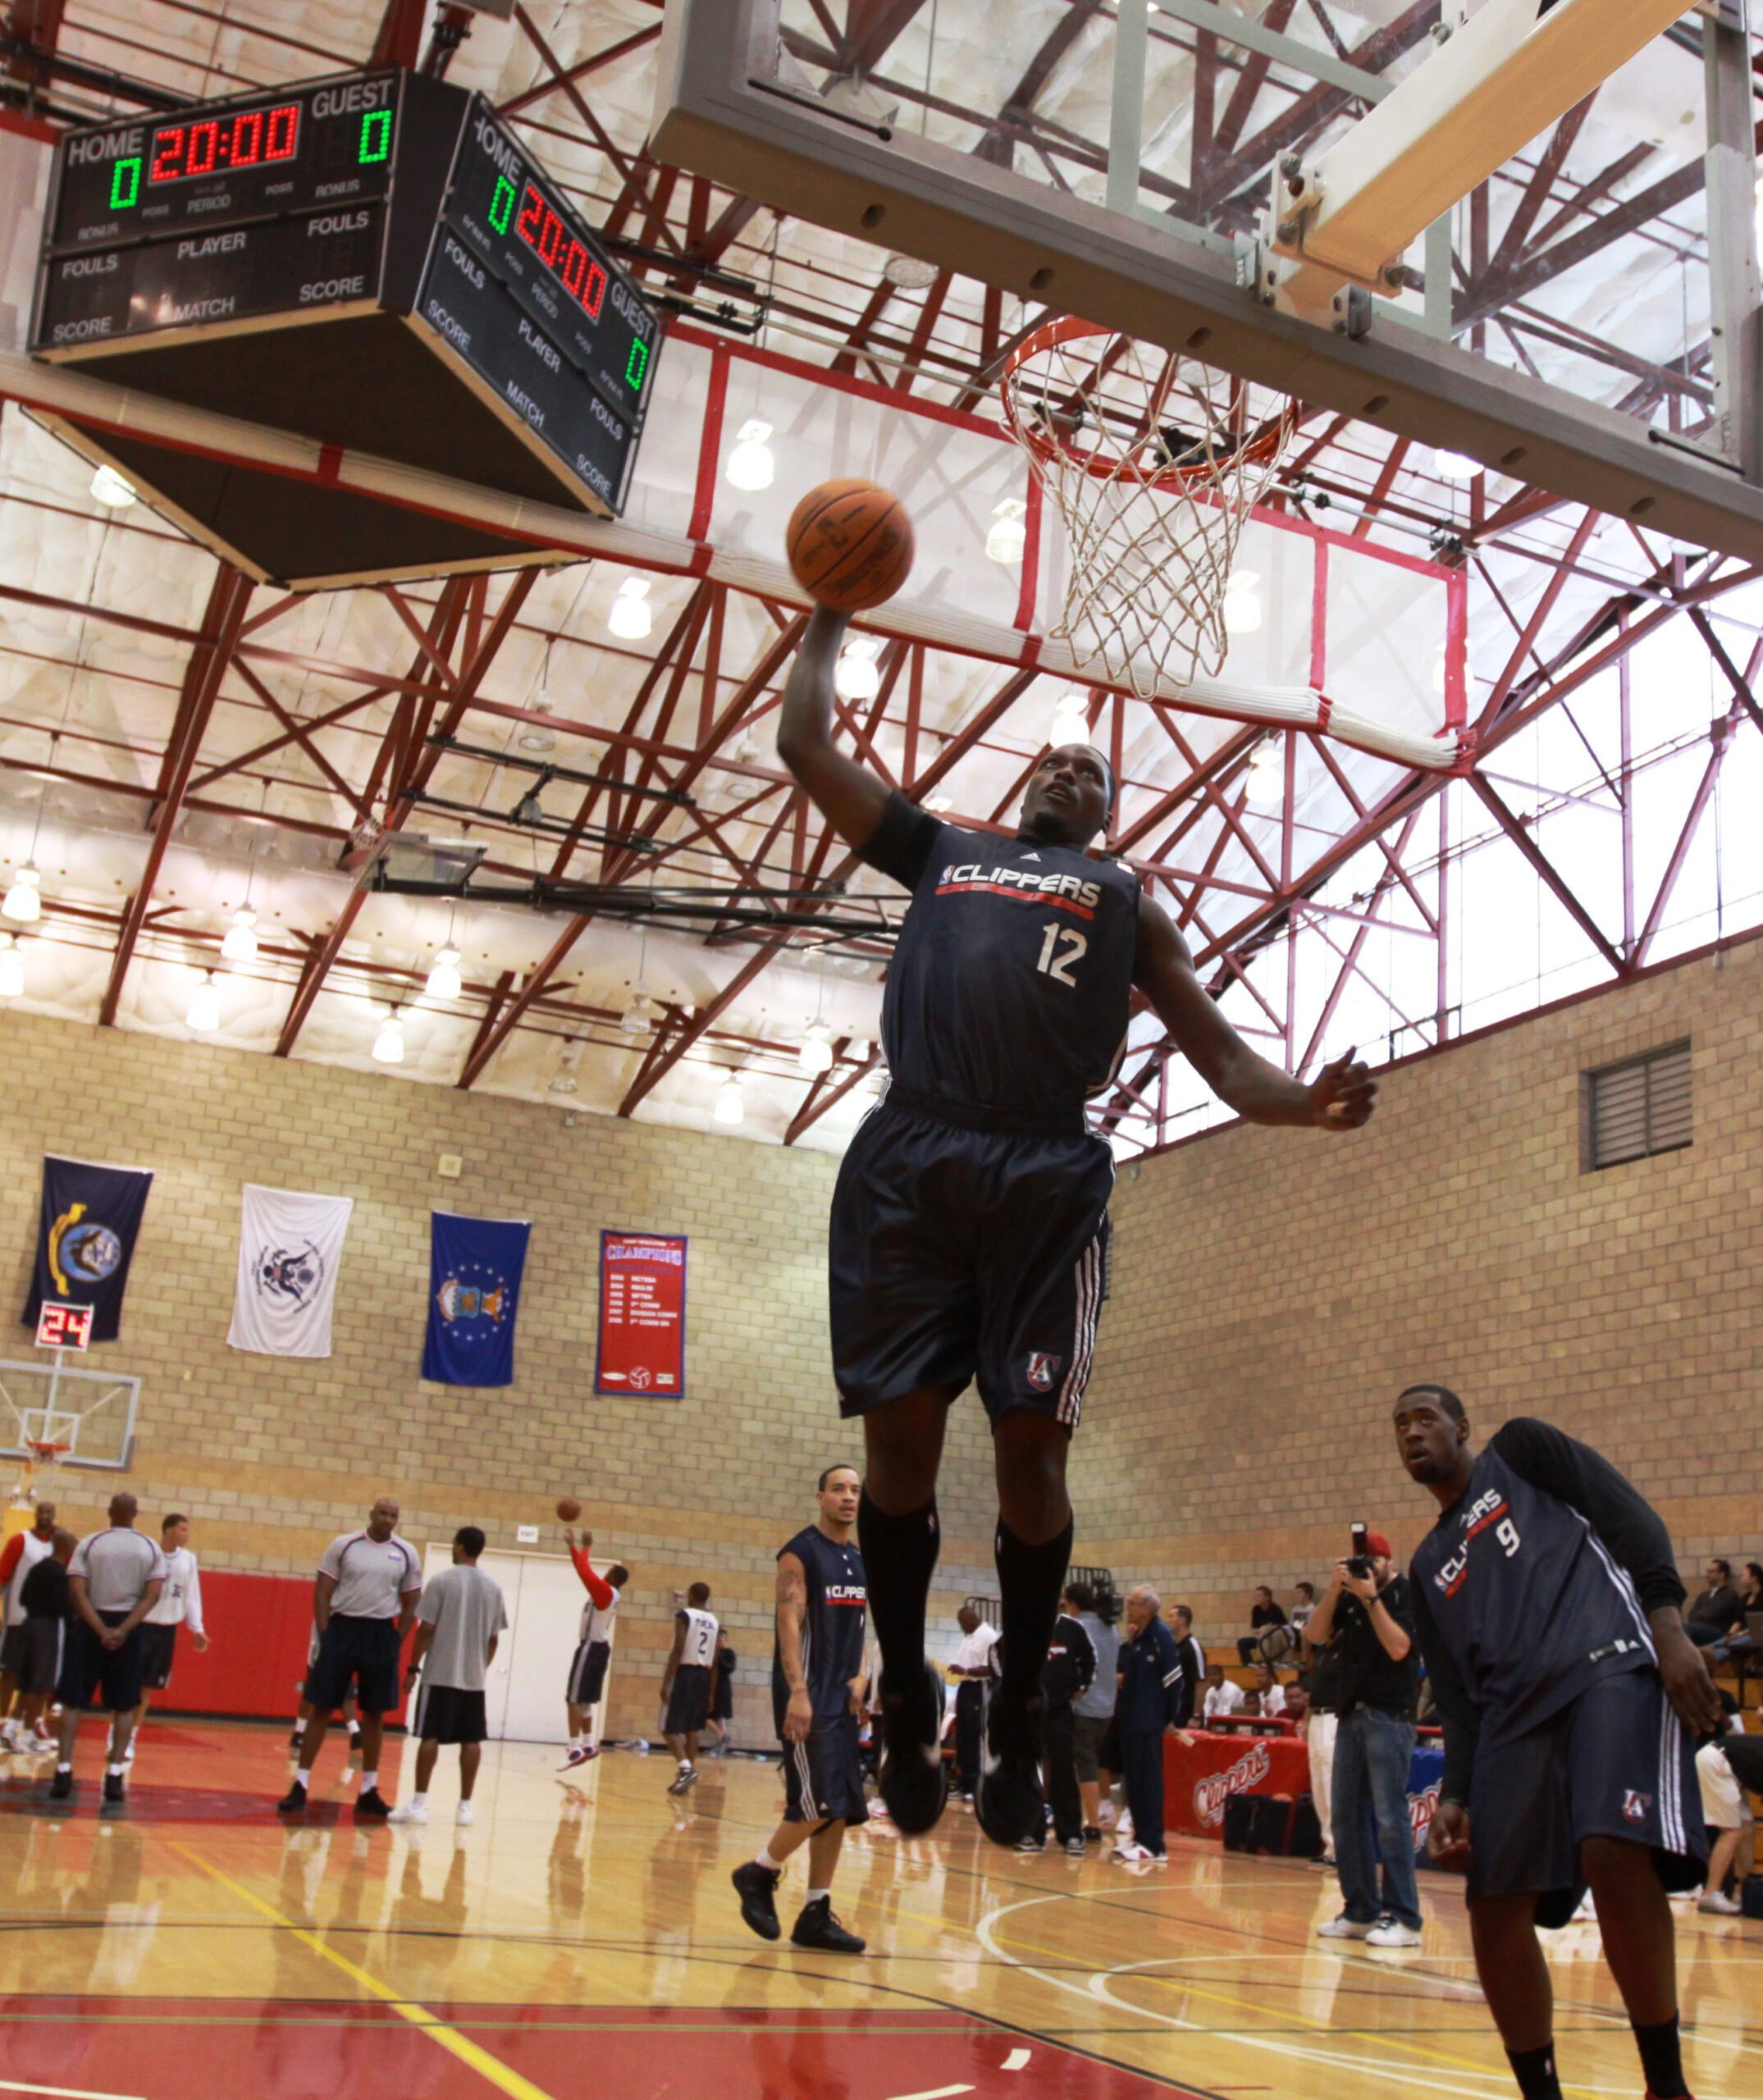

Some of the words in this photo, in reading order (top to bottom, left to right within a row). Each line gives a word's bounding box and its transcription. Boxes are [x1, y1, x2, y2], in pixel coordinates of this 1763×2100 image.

[312, 83, 391, 119] GUEST
[68, 128, 144, 163] HOME
[151, 106, 299, 182] 20:00
[359, 110, 391, 163] 0
[110, 158, 142, 209] 0
[187, 194, 231, 213] PERIOD
[308, 212, 369, 236] FOULS
[488, 175, 516, 235] 0
[62, 254, 118, 279] FOULS
[177, 232, 246, 260] PLAYER
[445, 238, 485, 290] FOULS
[516, 185, 608, 319] 20:00
[173, 297, 235, 321] MATCH
[299, 276, 364, 302] SCORE
[53, 316, 112, 341] SCORE
[427, 299, 472, 353] SCORE
[611, 281, 653, 342] GUEST
[518, 317, 561, 373] PLAYER
[625, 337, 648, 390] 0
[506, 380, 545, 428] MATCH
[590, 397, 623, 441] FOULS
[576, 454, 612, 496] SCORE
[952, 865, 1102, 908] CLIPPERS
[1037, 922, 1088, 988] 12
[605, 1244, 683, 1266] CHAMPIONS
[39, 1306, 90, 1348] 24
[1496, 1518, 1521, 1558] 9
[698, 1632, 708, 1655] 2
